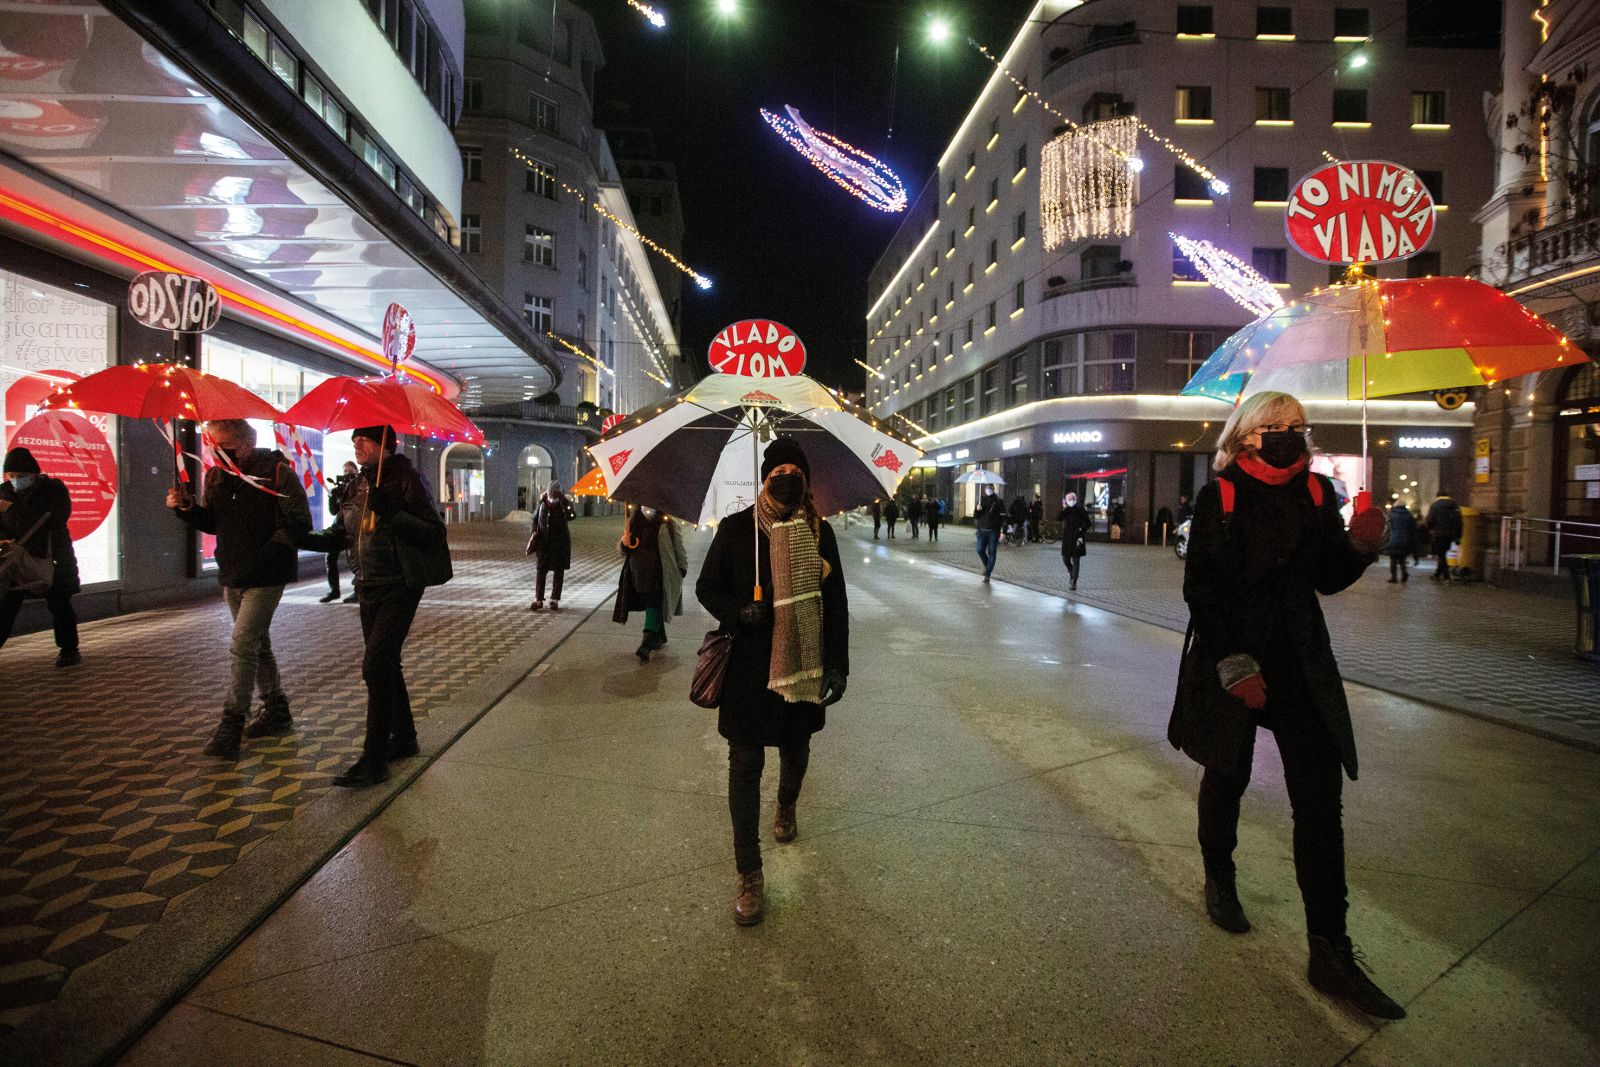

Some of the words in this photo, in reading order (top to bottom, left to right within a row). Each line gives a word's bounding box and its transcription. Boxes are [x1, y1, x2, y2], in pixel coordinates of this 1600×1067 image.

[1288, 177, 1330, 220] TO
[1337, 163, 1371, 201] NI
[1376, 164, 1432, 236] MOJA
[1312, 211, 1417, 262] VLADA
[715, 322, 797, 353] VLADO
[1053, 431, 1102, 444] MANGO
